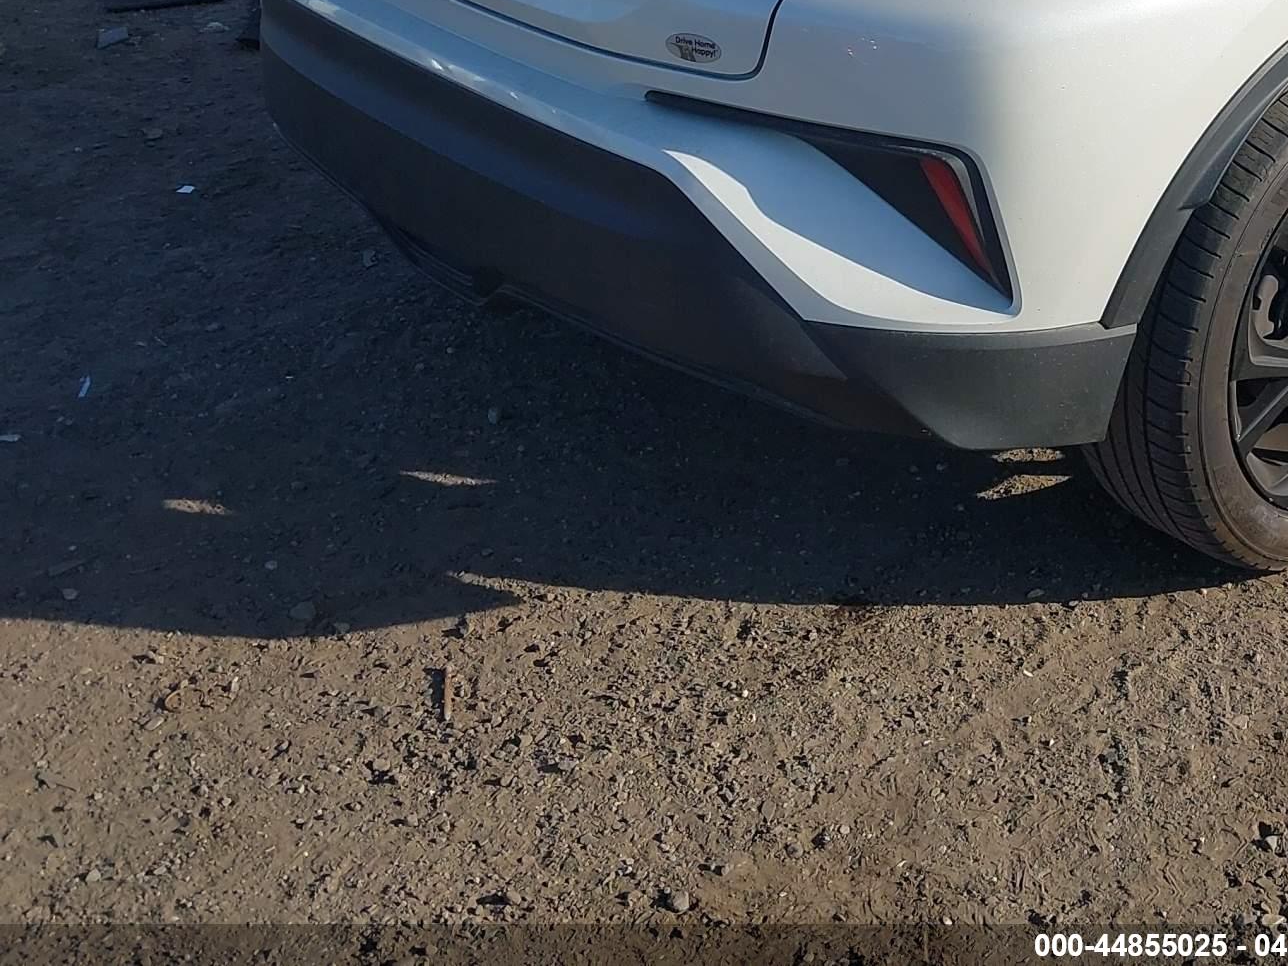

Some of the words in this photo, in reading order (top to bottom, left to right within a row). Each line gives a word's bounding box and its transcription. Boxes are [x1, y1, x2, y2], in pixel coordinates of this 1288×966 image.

[675, 36, 692, 45] Drive
[694, 39, 716, 49] Home
[692, 47, 717, 58] Happy!
